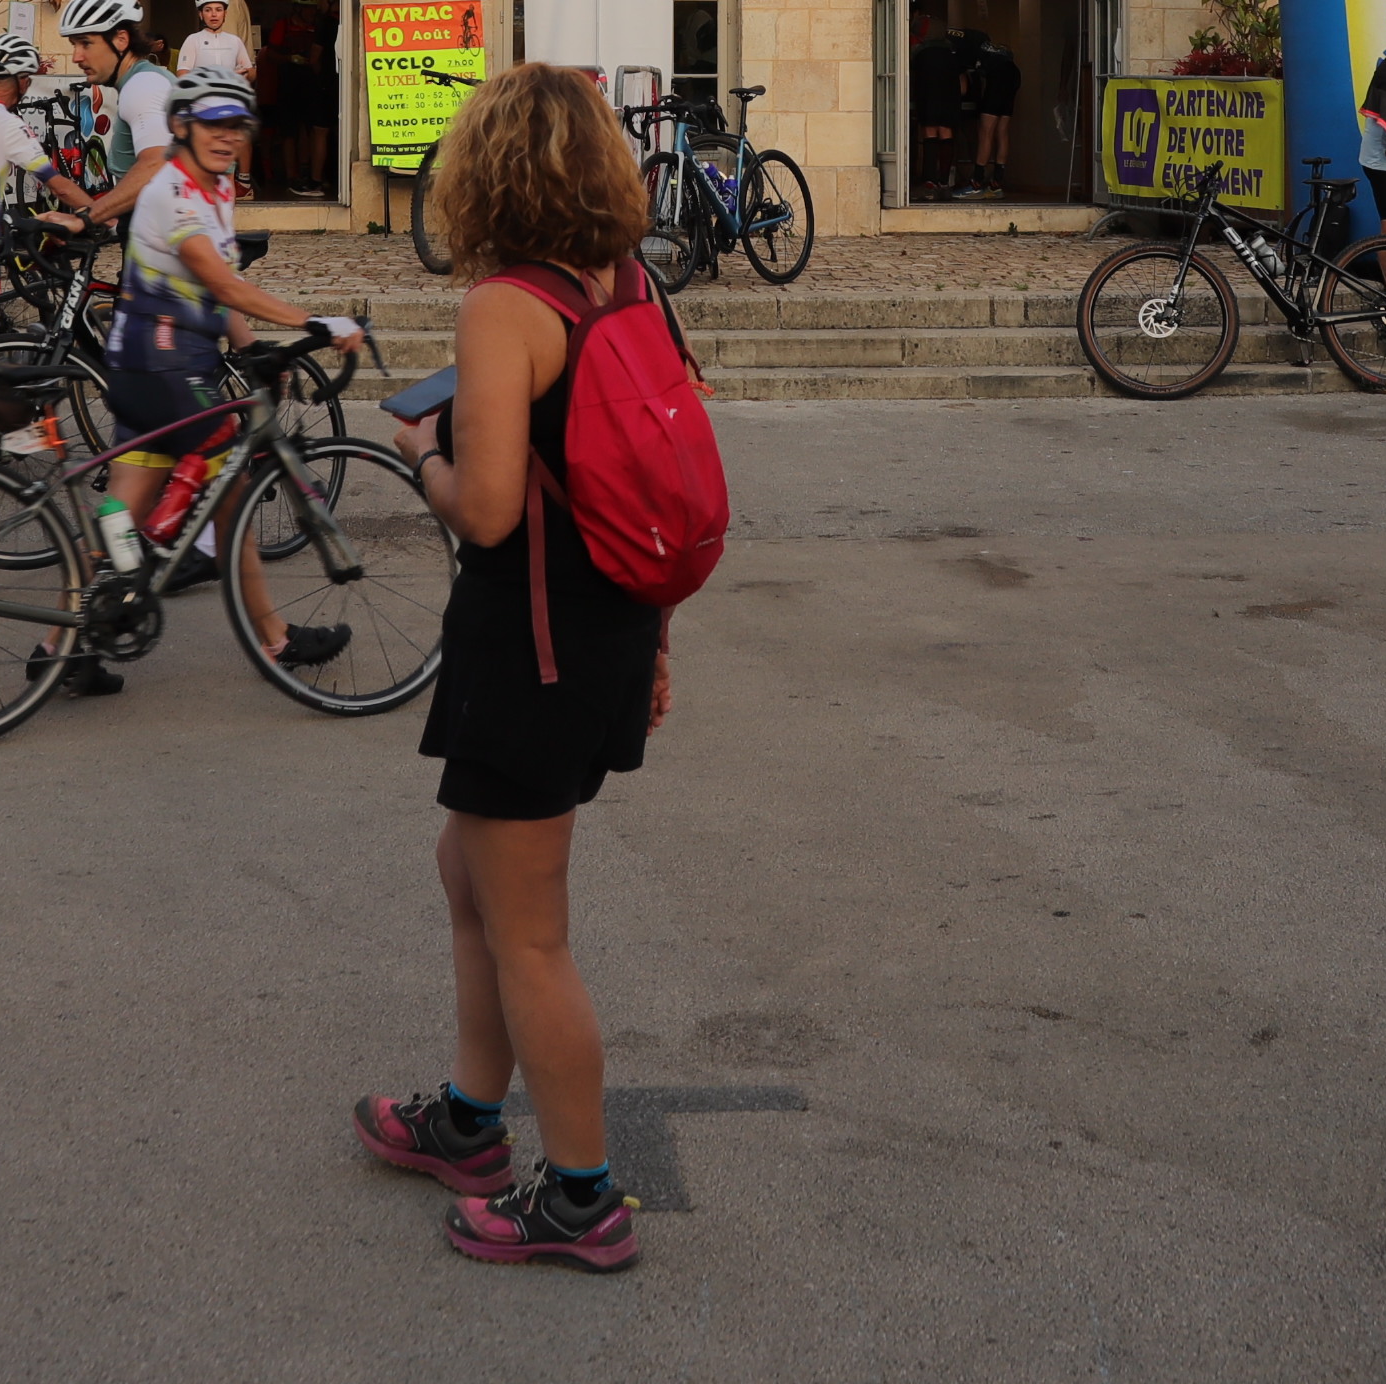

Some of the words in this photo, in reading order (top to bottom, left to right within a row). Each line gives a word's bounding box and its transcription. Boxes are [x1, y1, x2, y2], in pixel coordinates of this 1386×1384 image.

[366, 5, 453, 23] VAYRAC
[368, 27, 404, 47] 10
[412, 29, 452, 41] Août
[371, 56, 435, 71] CYCLO
[1165, 89, 1266, 118] PARTENAIRE
[377, 118, 418, 127] RANDO
[422, 117, 451, 125] PEDE
[1121, 107, 1157, 158] LOT
[1166, 126, 1187, 154] DE
[1190, 127, 1245, 157] VOTRE
[61, 269, 86, 329] GIANT
